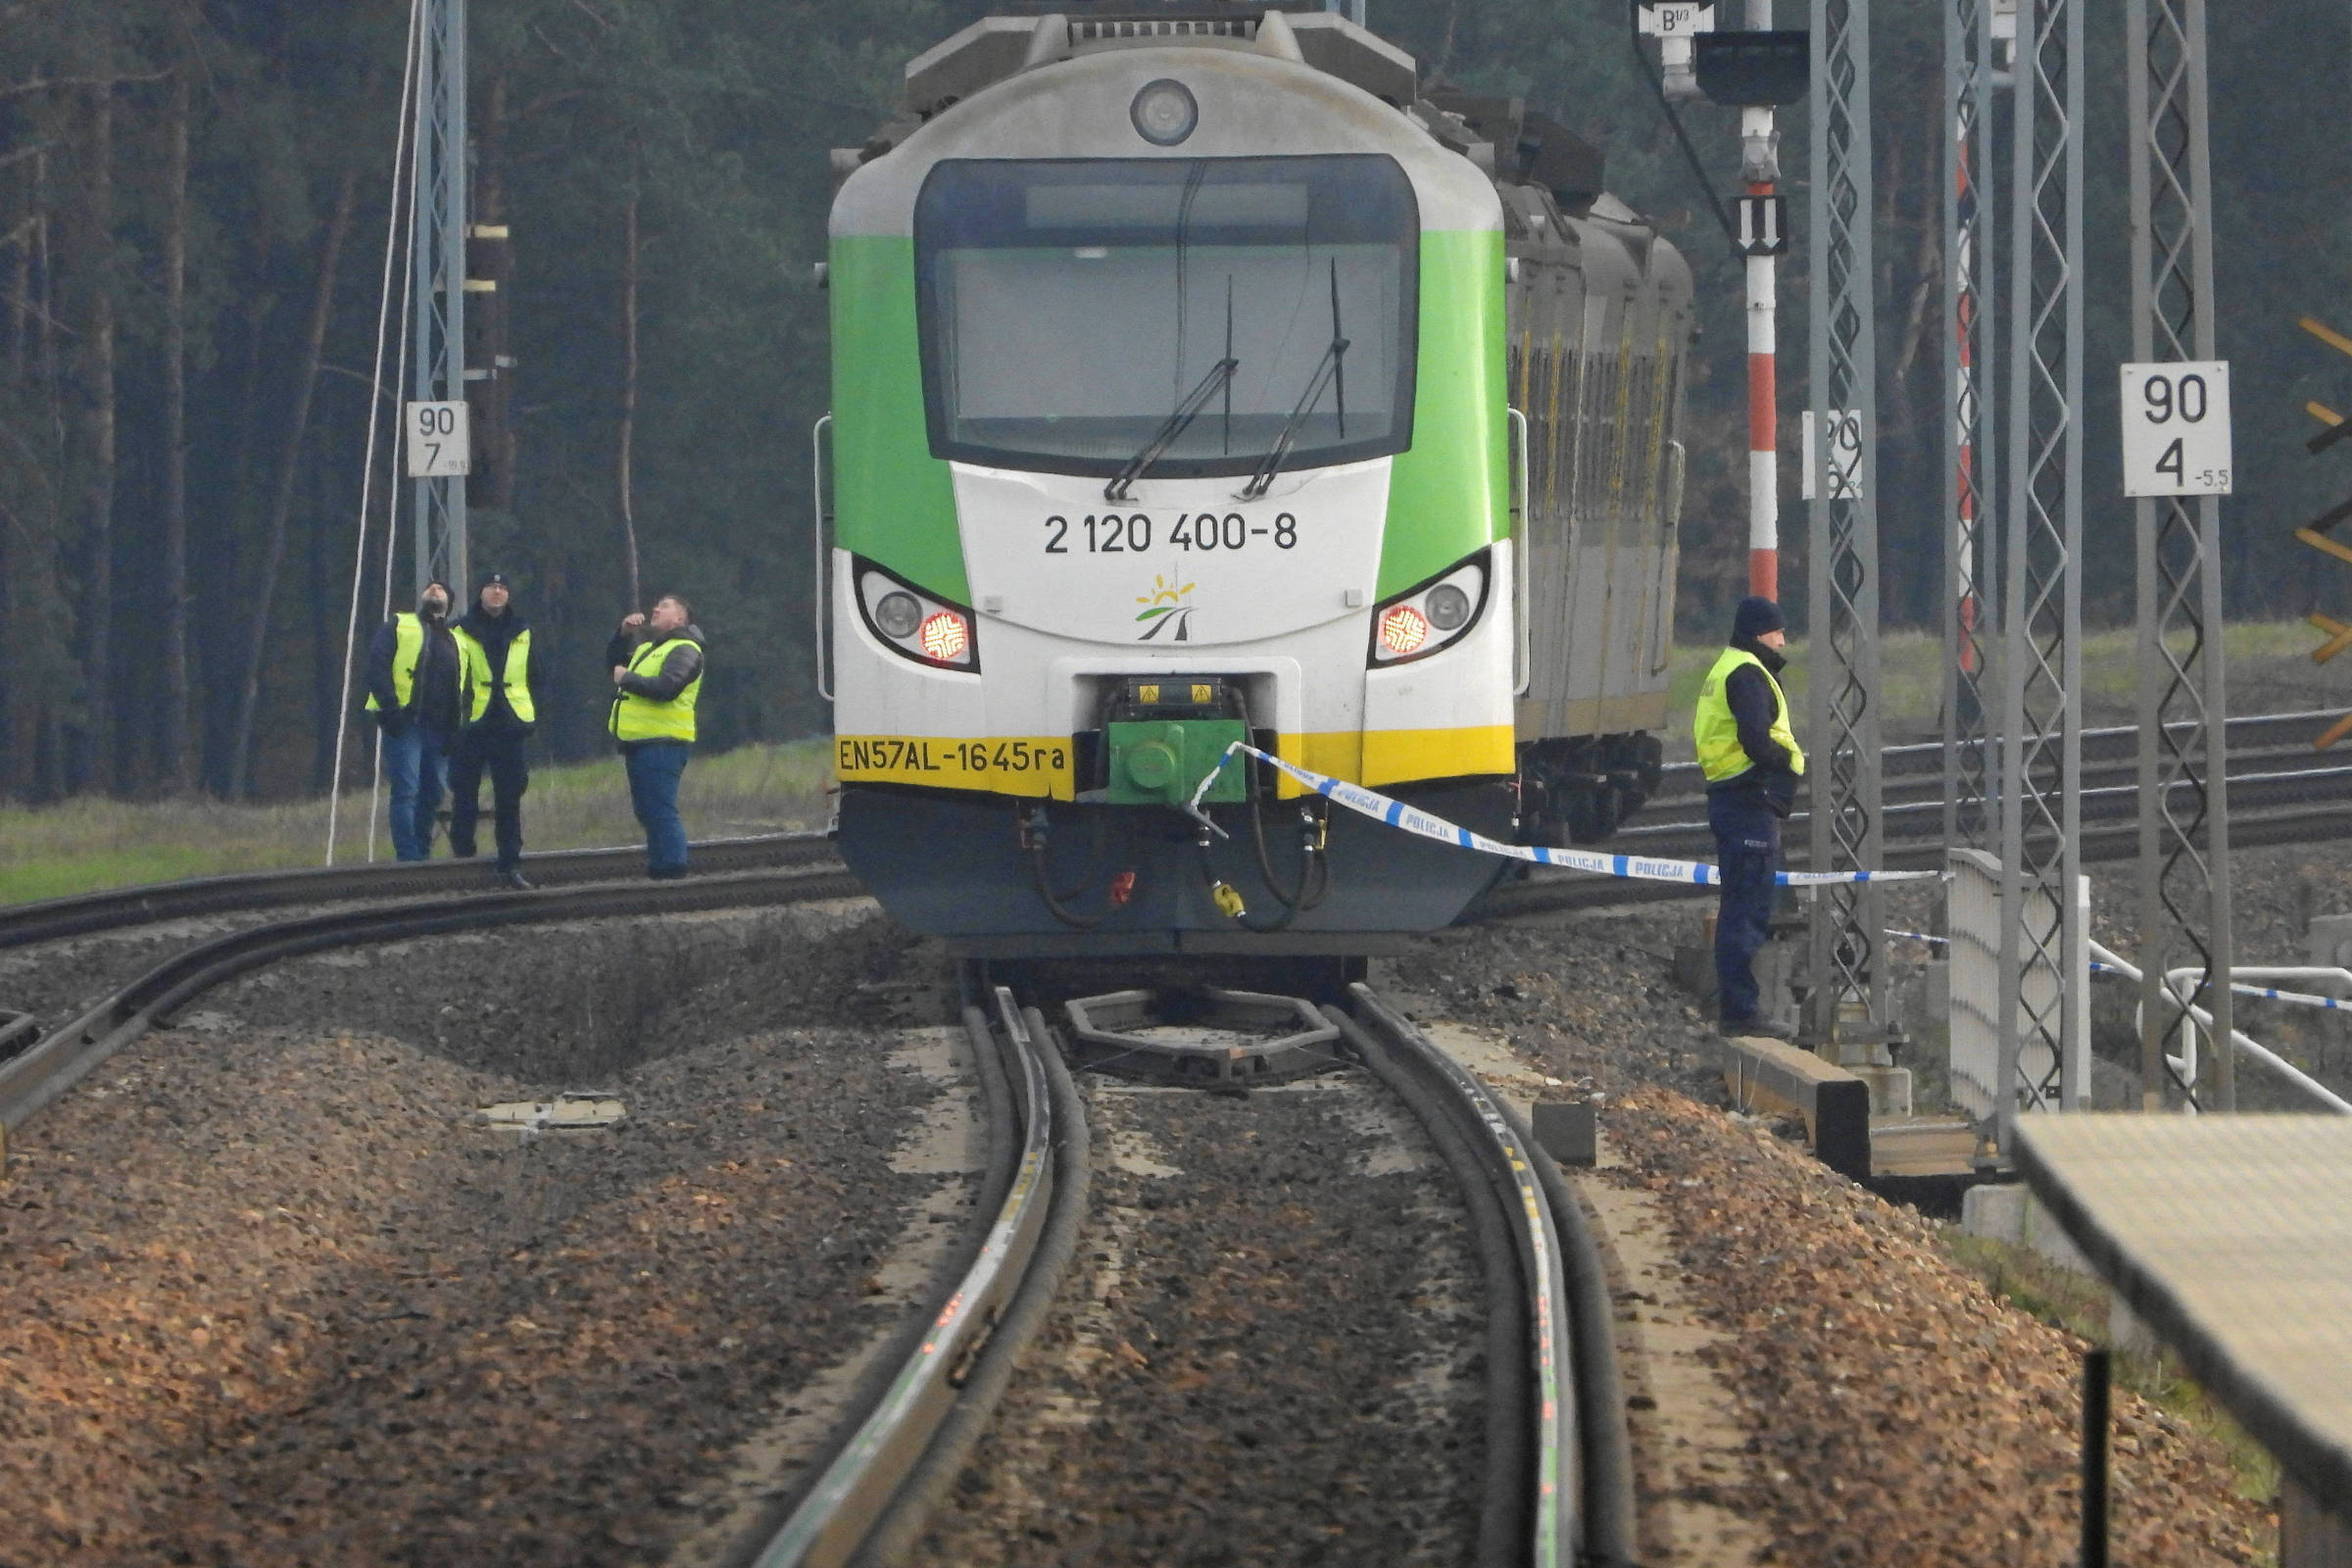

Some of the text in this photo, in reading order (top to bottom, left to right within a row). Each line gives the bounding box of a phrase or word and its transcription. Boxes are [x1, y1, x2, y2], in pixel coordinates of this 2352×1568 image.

[2144, 373, 2207, 424] 90
[419, 408, 455, 436] 90
[423, 442, 441, 471] 7
[2155, 437, 2184, 487] 4
[1044, 513, 1298, 554] 2 120 400-8
[1405, 813, 1450, 840] POLICJA
[1558, 854, 1605, 871] POLICJA
[1635, 860, 1685, 879] POLICJA
